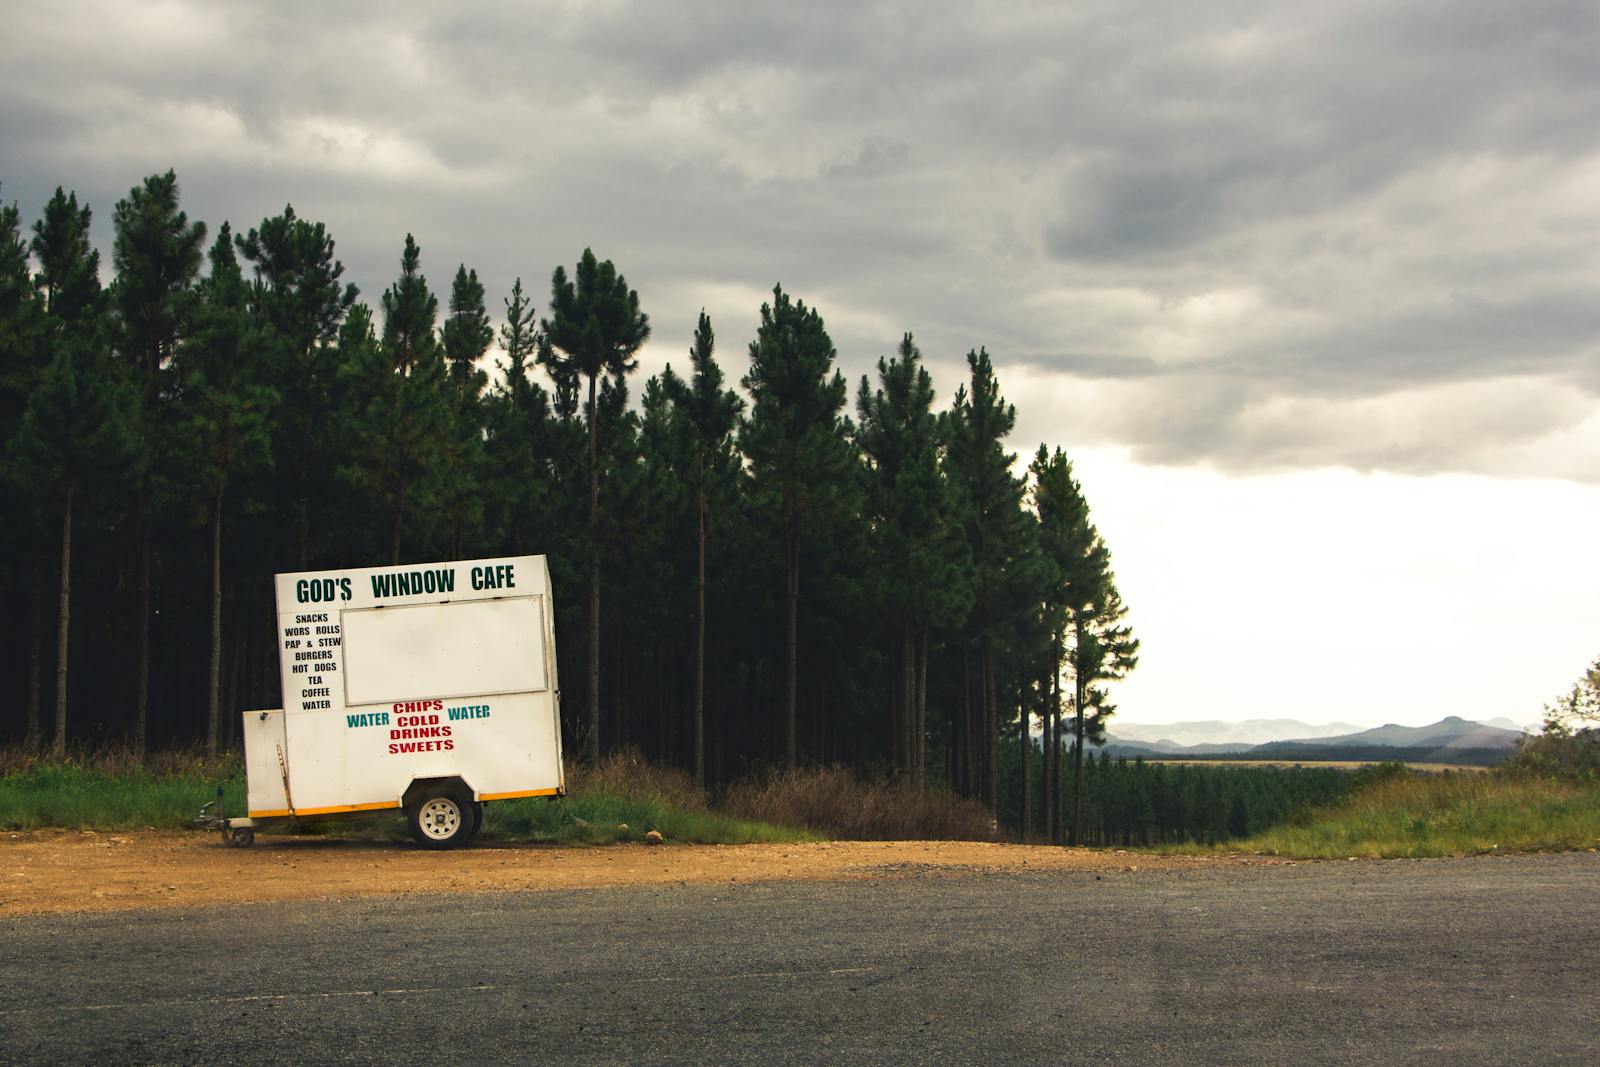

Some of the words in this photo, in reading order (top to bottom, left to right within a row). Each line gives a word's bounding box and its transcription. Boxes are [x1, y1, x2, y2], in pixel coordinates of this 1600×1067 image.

[297, 578, 351, 603] GOD'S
[371, 569, 454, 597] WINDOW
[471, 565, 515, 590] CAFE
[296, 614, 328, 623] SNACKS
[285, 627, 309, 636] WORS
[316, 625, 340, 634] ROLLS
[286, 640, 300, 649] PAP
[319, 638, 340, 647] STEW
[296, 651, 332, 661] BURGERS
[293, 665, 308, 673] HOT
[315, 663, 336, 672] DOGS
[308, 676, 322, 684] TEA
[302, 688, 329, 697] COFFEE
[303, 700, 330, 710] WATER
[393, 700, 443, 713] CHIPS
[448, 705, 489, 720] WATER
[347, 713, 389, 727] WATER
[398, 715, 439, 727] COLD
[391, 726, 451, 739] DRINKS
[389, 739, 454, 754] SWEETS
